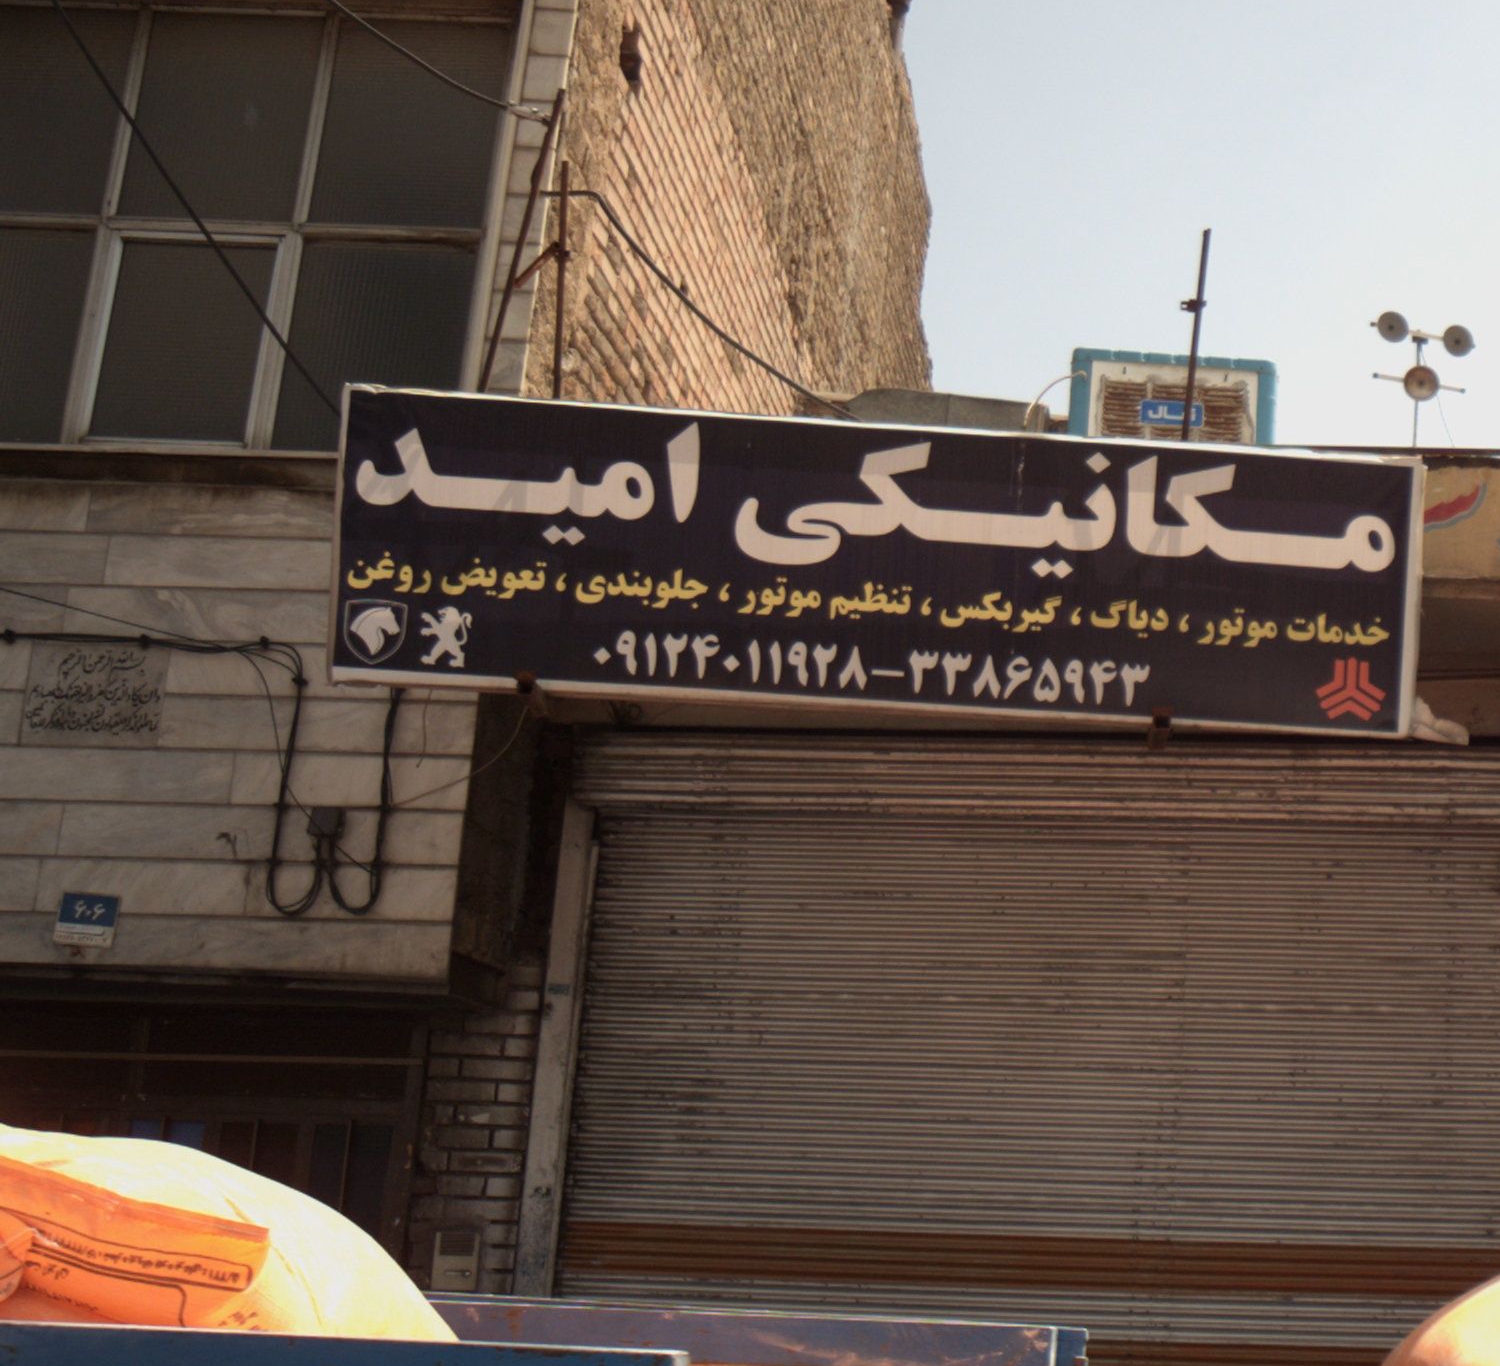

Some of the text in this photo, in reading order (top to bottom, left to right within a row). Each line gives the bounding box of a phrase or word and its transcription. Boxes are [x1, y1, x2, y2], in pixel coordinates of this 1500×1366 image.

[355, 421, 1396, 579] مکانیکی امید
[347, 551, 432, 594] روغن
[441, 558, 547, 600] تعویض
[575, 568, 709, 613] جلوبندی
[737, 578, 822, 617] موتور
[829, 581, 912, 620] تنظیم
[939, 591, 1062, 634] گیربکس
[1089, 601, 1169, 639] دیاگ
[1197, 607, 1278, 649] موتور
[1286, 612, 1389, 647] خدمات
